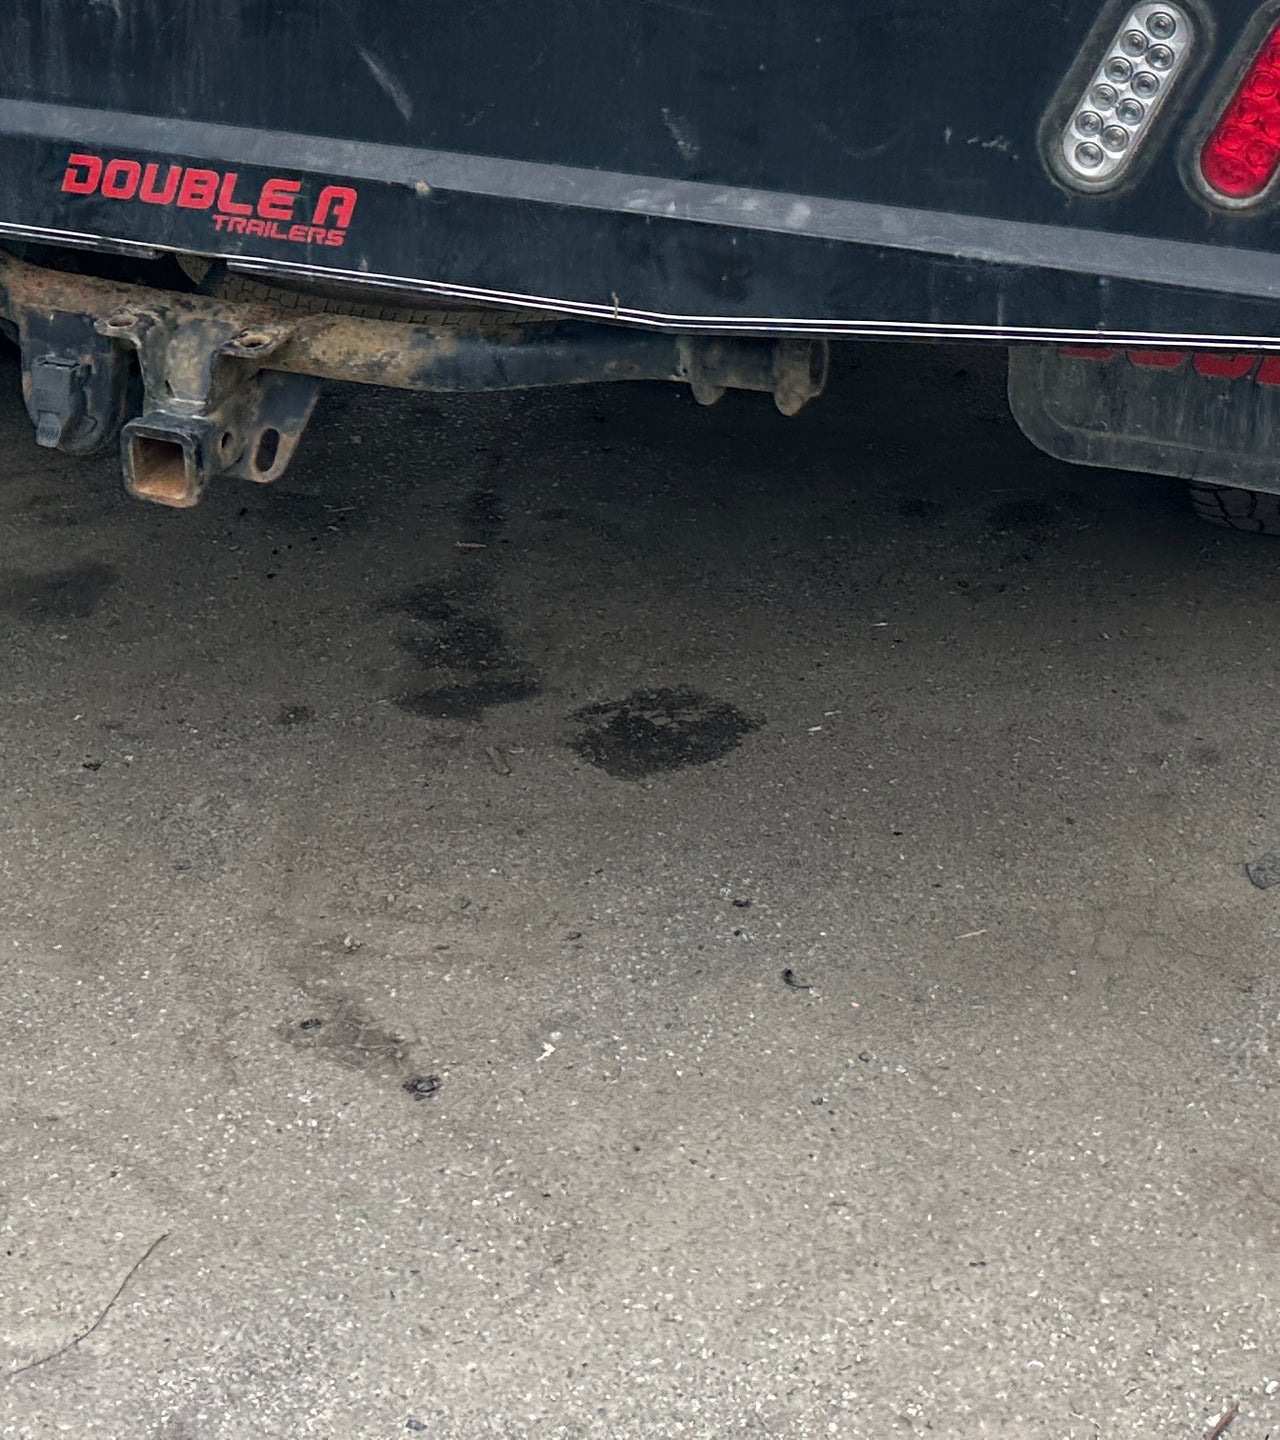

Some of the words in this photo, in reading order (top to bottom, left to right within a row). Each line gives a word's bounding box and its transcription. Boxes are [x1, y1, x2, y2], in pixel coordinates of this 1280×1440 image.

[61, 153, 301, 220] DOUBLE
[312, 185, 358, 228] A
[212, 214, 347, 247] TRAILERS
